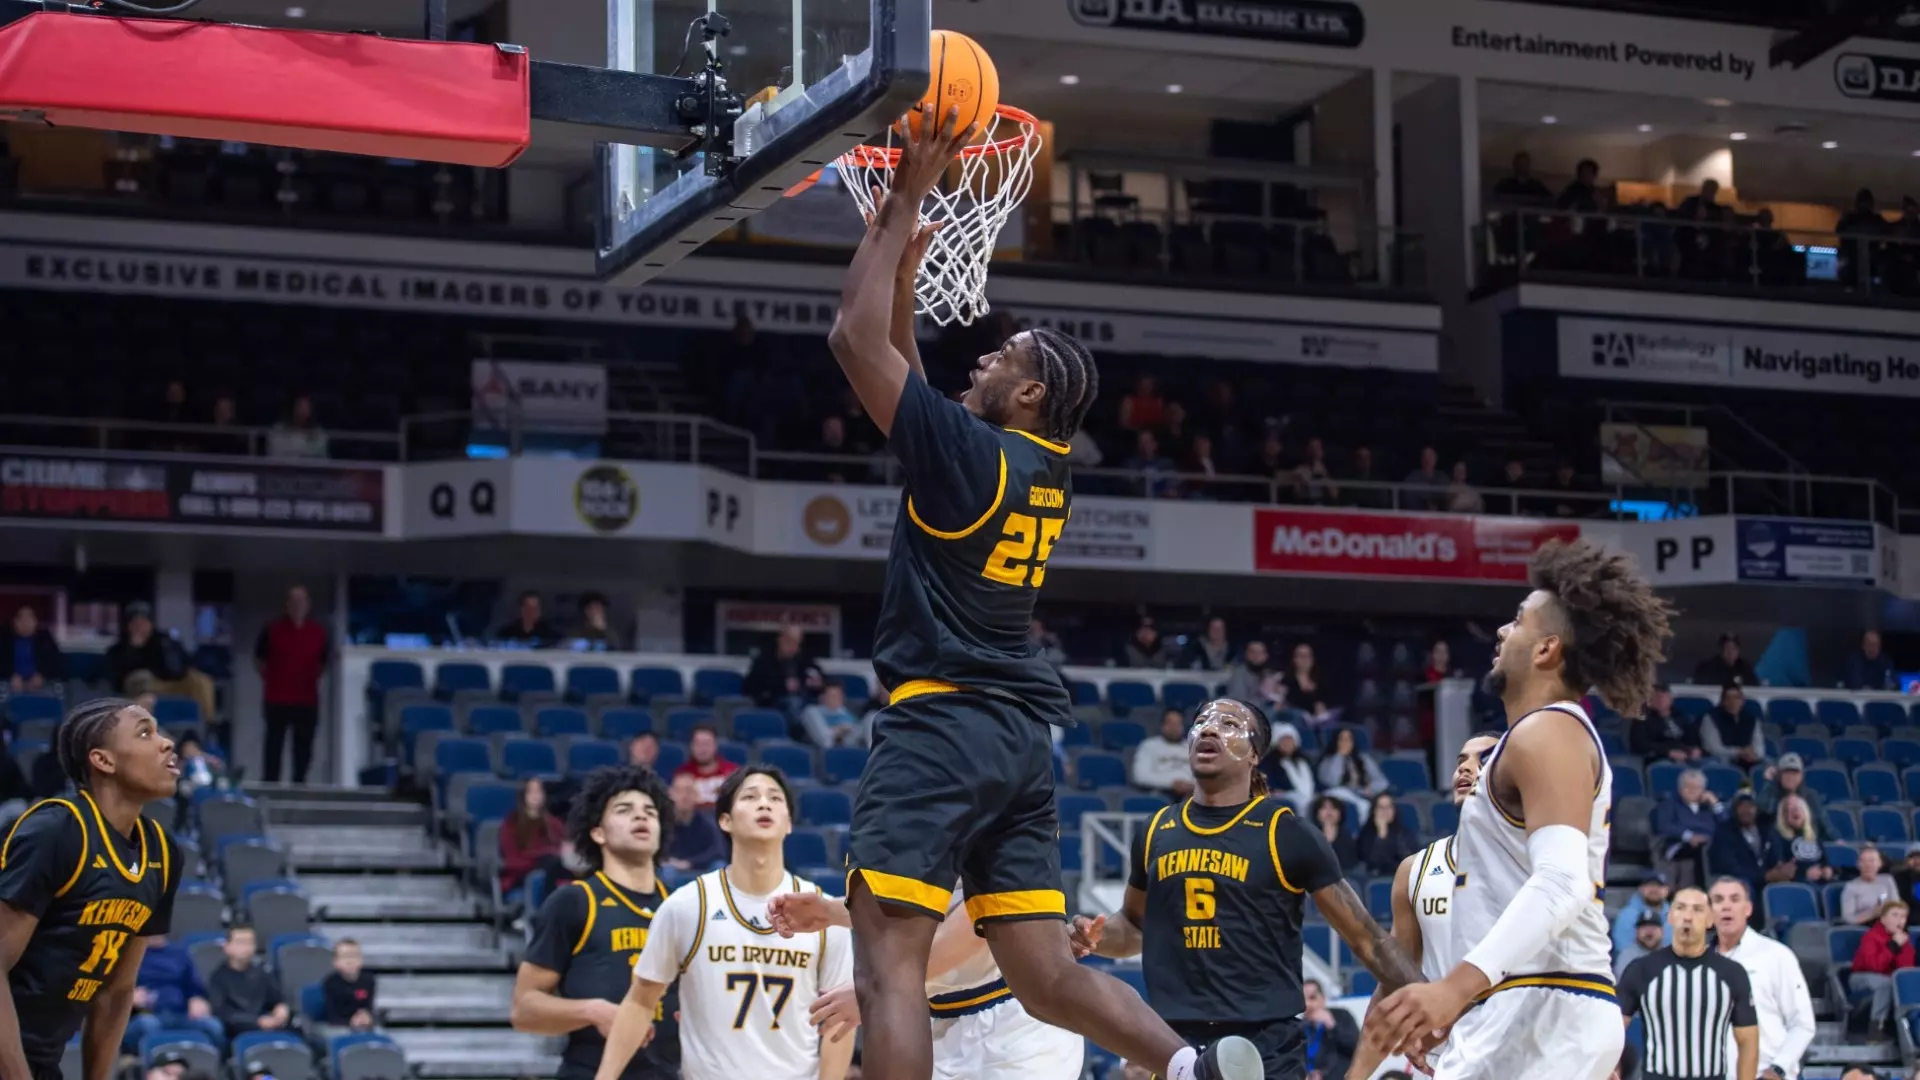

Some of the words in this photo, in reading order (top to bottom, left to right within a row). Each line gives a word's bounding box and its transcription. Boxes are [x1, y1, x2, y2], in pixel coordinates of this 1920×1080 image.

[1196, 5, 1296, 29] ELECTRIC
[1452, 26, 1618, 62] Entertainment
[1625, 43, 1723, 73] Powered
[1729, 53, 1755, 81] by
[26, 255, 221, 288] EXCLUSIVE
[236, 268, 386, 299] MEDICAL
[401, 279, 551, 308] IMAGERS
[563, 287, 603, 311] OF
[616, 292, 699, 317] YOUR
[1744, 346, 1881, 384] Navigating
[431, 484, 454, 519] Q
[471, 479, 496, 515] Q
[707, 488, 720, 526] P
[726, 495, 740, 531] P
[981, 512, 1066, 588] 25
[1271, 524, 1458, 563] McDonald's
[1656, 536, 1679, 571] P
[1691, 536, 1714, 569] P
[1157, 848, 1250, 883] KENNESAW
[1184, 877, 1217, 920] 6
[1422, 896, 1448, 916] UC
[78, 929, 129, 975] 14
[708, 945, 736, 962] UC
[742, 945, 812, 969] IRVINE
[1183, 926, 1222, 949] STATE
[725, 972, 795, 1031] 77
